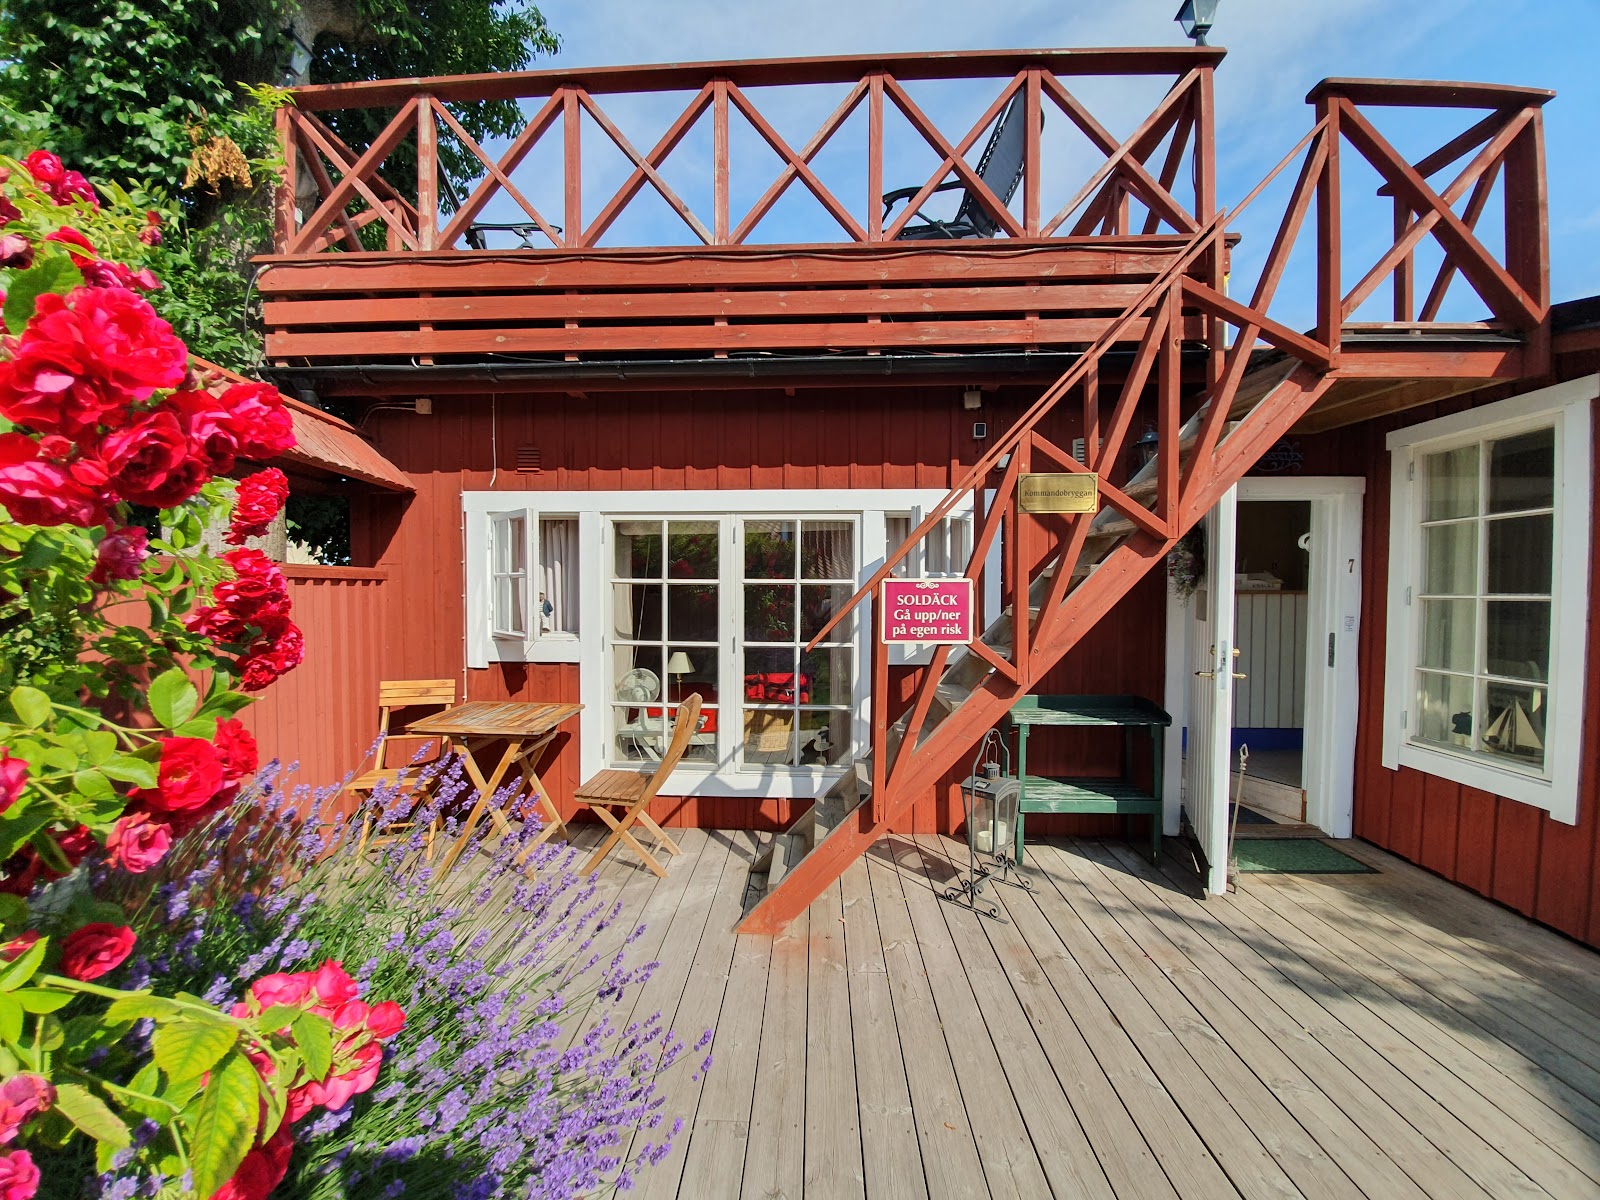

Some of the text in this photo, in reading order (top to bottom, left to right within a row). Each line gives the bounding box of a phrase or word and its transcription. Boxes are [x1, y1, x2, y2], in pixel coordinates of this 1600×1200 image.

[1024, 489, 1093, 499] Kommandobryggan
[1348, 558, 1355, 574] 7
[897, 592, 958, 606] SOLDÄCK
[893, 608, 961, 624] Gå upp/ner
[892, 623, 962, 638] på egen risk
